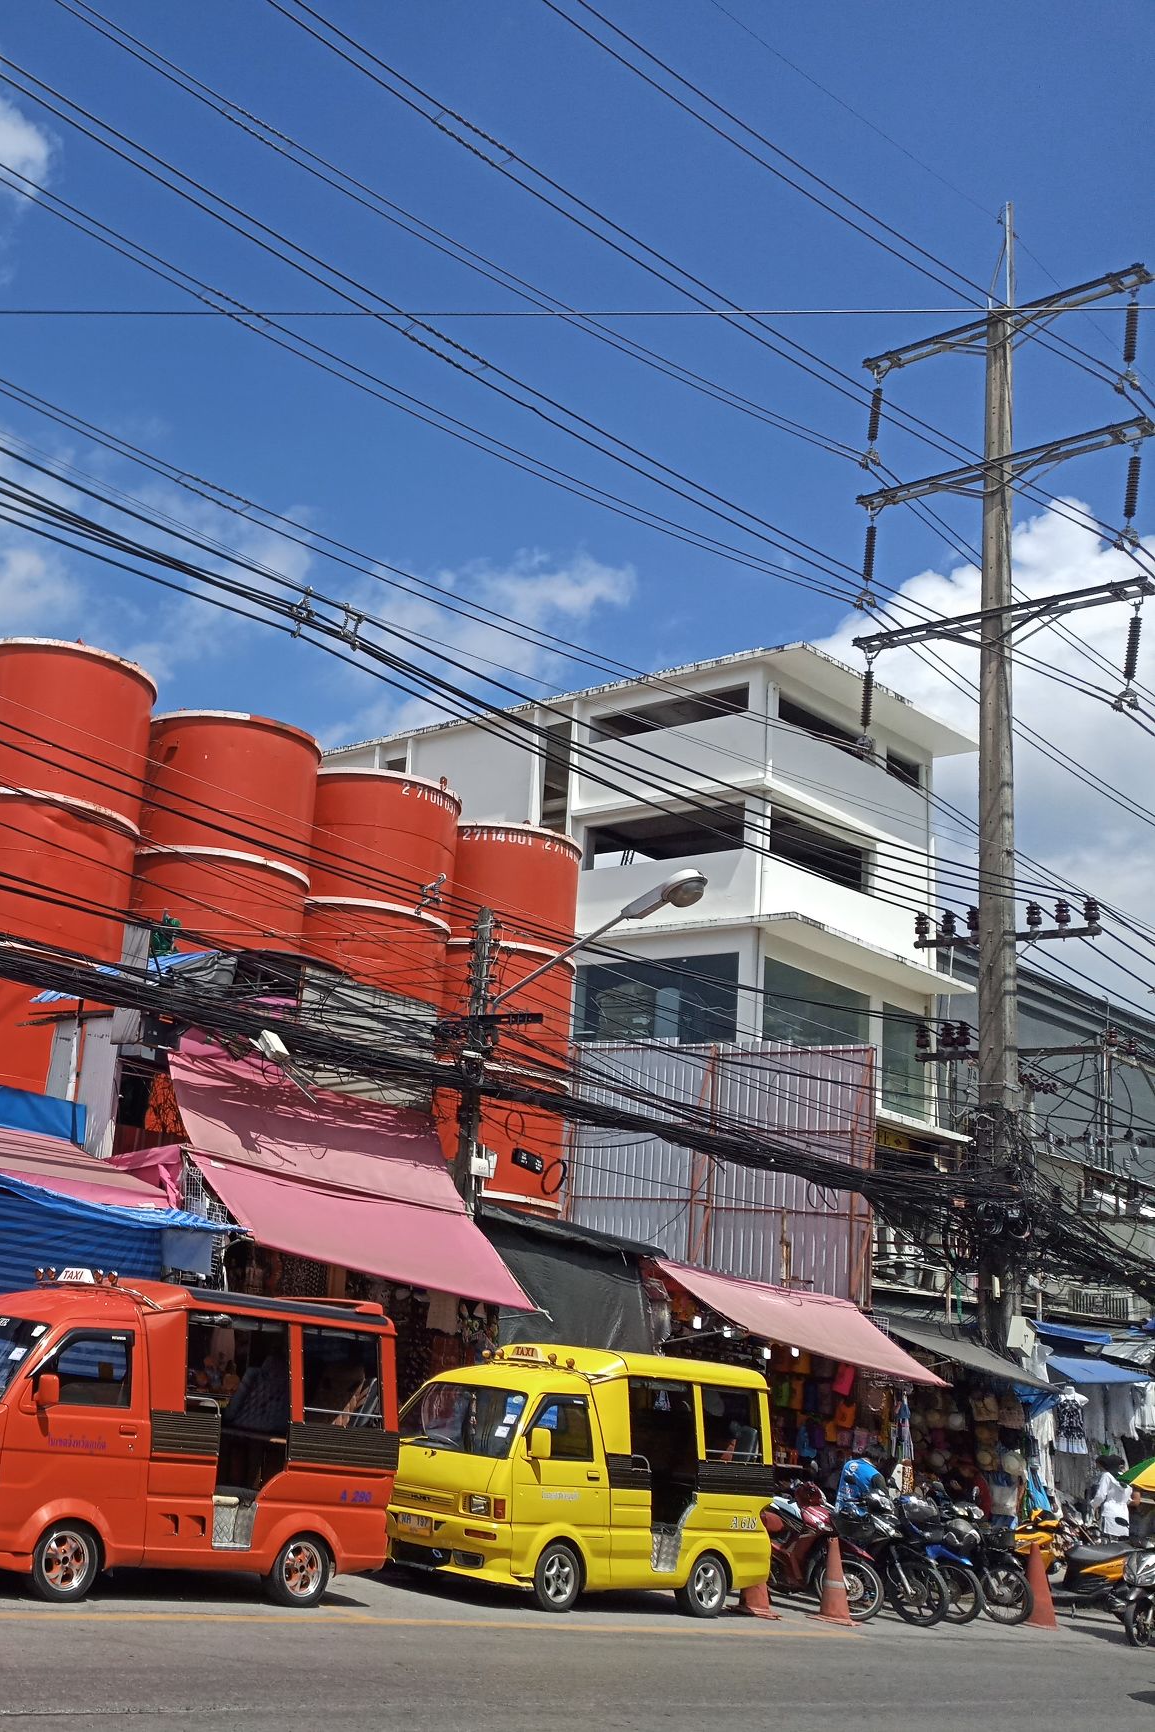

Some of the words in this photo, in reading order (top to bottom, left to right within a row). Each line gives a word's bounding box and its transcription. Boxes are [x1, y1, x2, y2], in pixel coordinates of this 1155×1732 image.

[63, 1270, 84, 1281] TAXI
[516, 1347, 535, 1357] TAXI
[340, 1489, 348, 1503] A
[730, 1515, 738, 1529] A
[740, 1516, 757, 1530] 618
